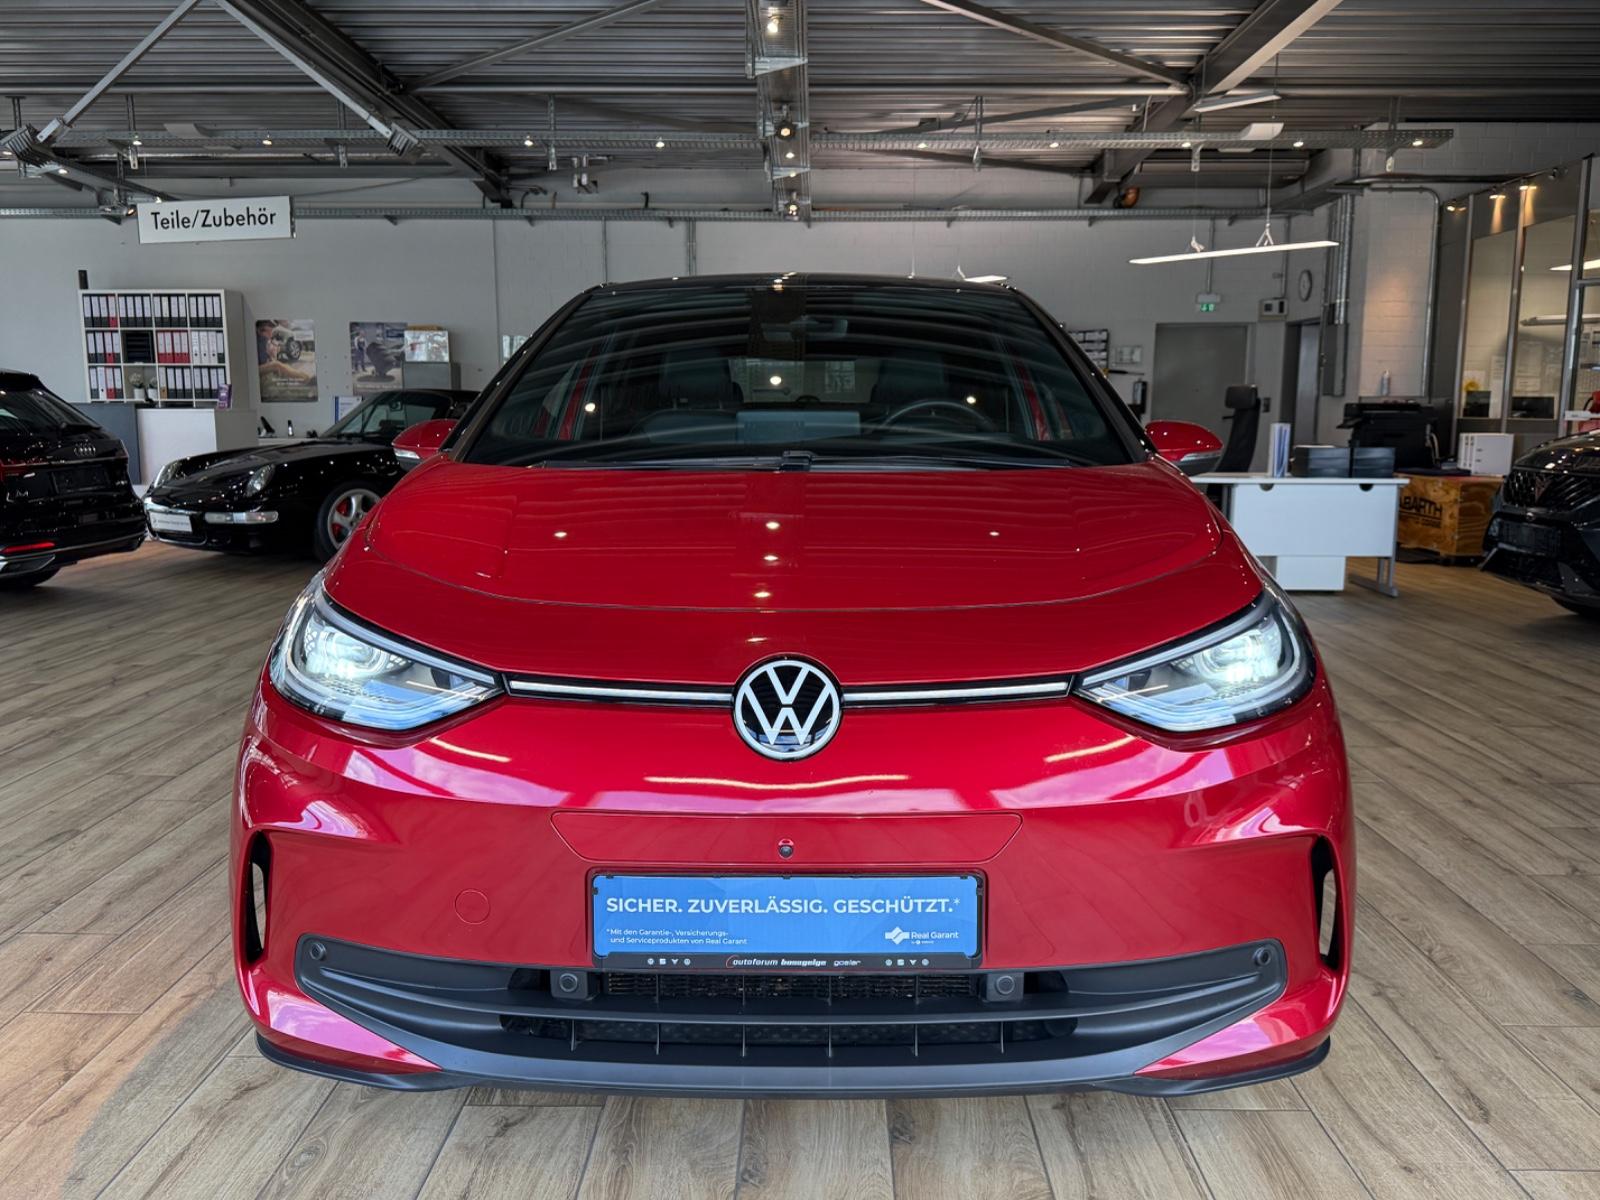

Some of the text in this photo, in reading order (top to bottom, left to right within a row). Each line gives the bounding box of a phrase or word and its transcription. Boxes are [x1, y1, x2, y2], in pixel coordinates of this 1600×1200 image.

[151, 206, 277, 231] Teile/Zubehör
[606, 897, 683, 913] SICHER.
[687, 895, 828, 914] ZUVERLÄSSIG.
[623, 928, 638, 936] den
[676, 929, 729, 939] Versicherungs-
[911, 931, 959, 940] Real Garant
[610, 936, 625, 944] und
[626, 936, 689, 946] Serviceprodukten
[705, 937, 721, 945] Real
[722, 937, 748, 945] Garant
[732, 957, 779, 967] autoforum
